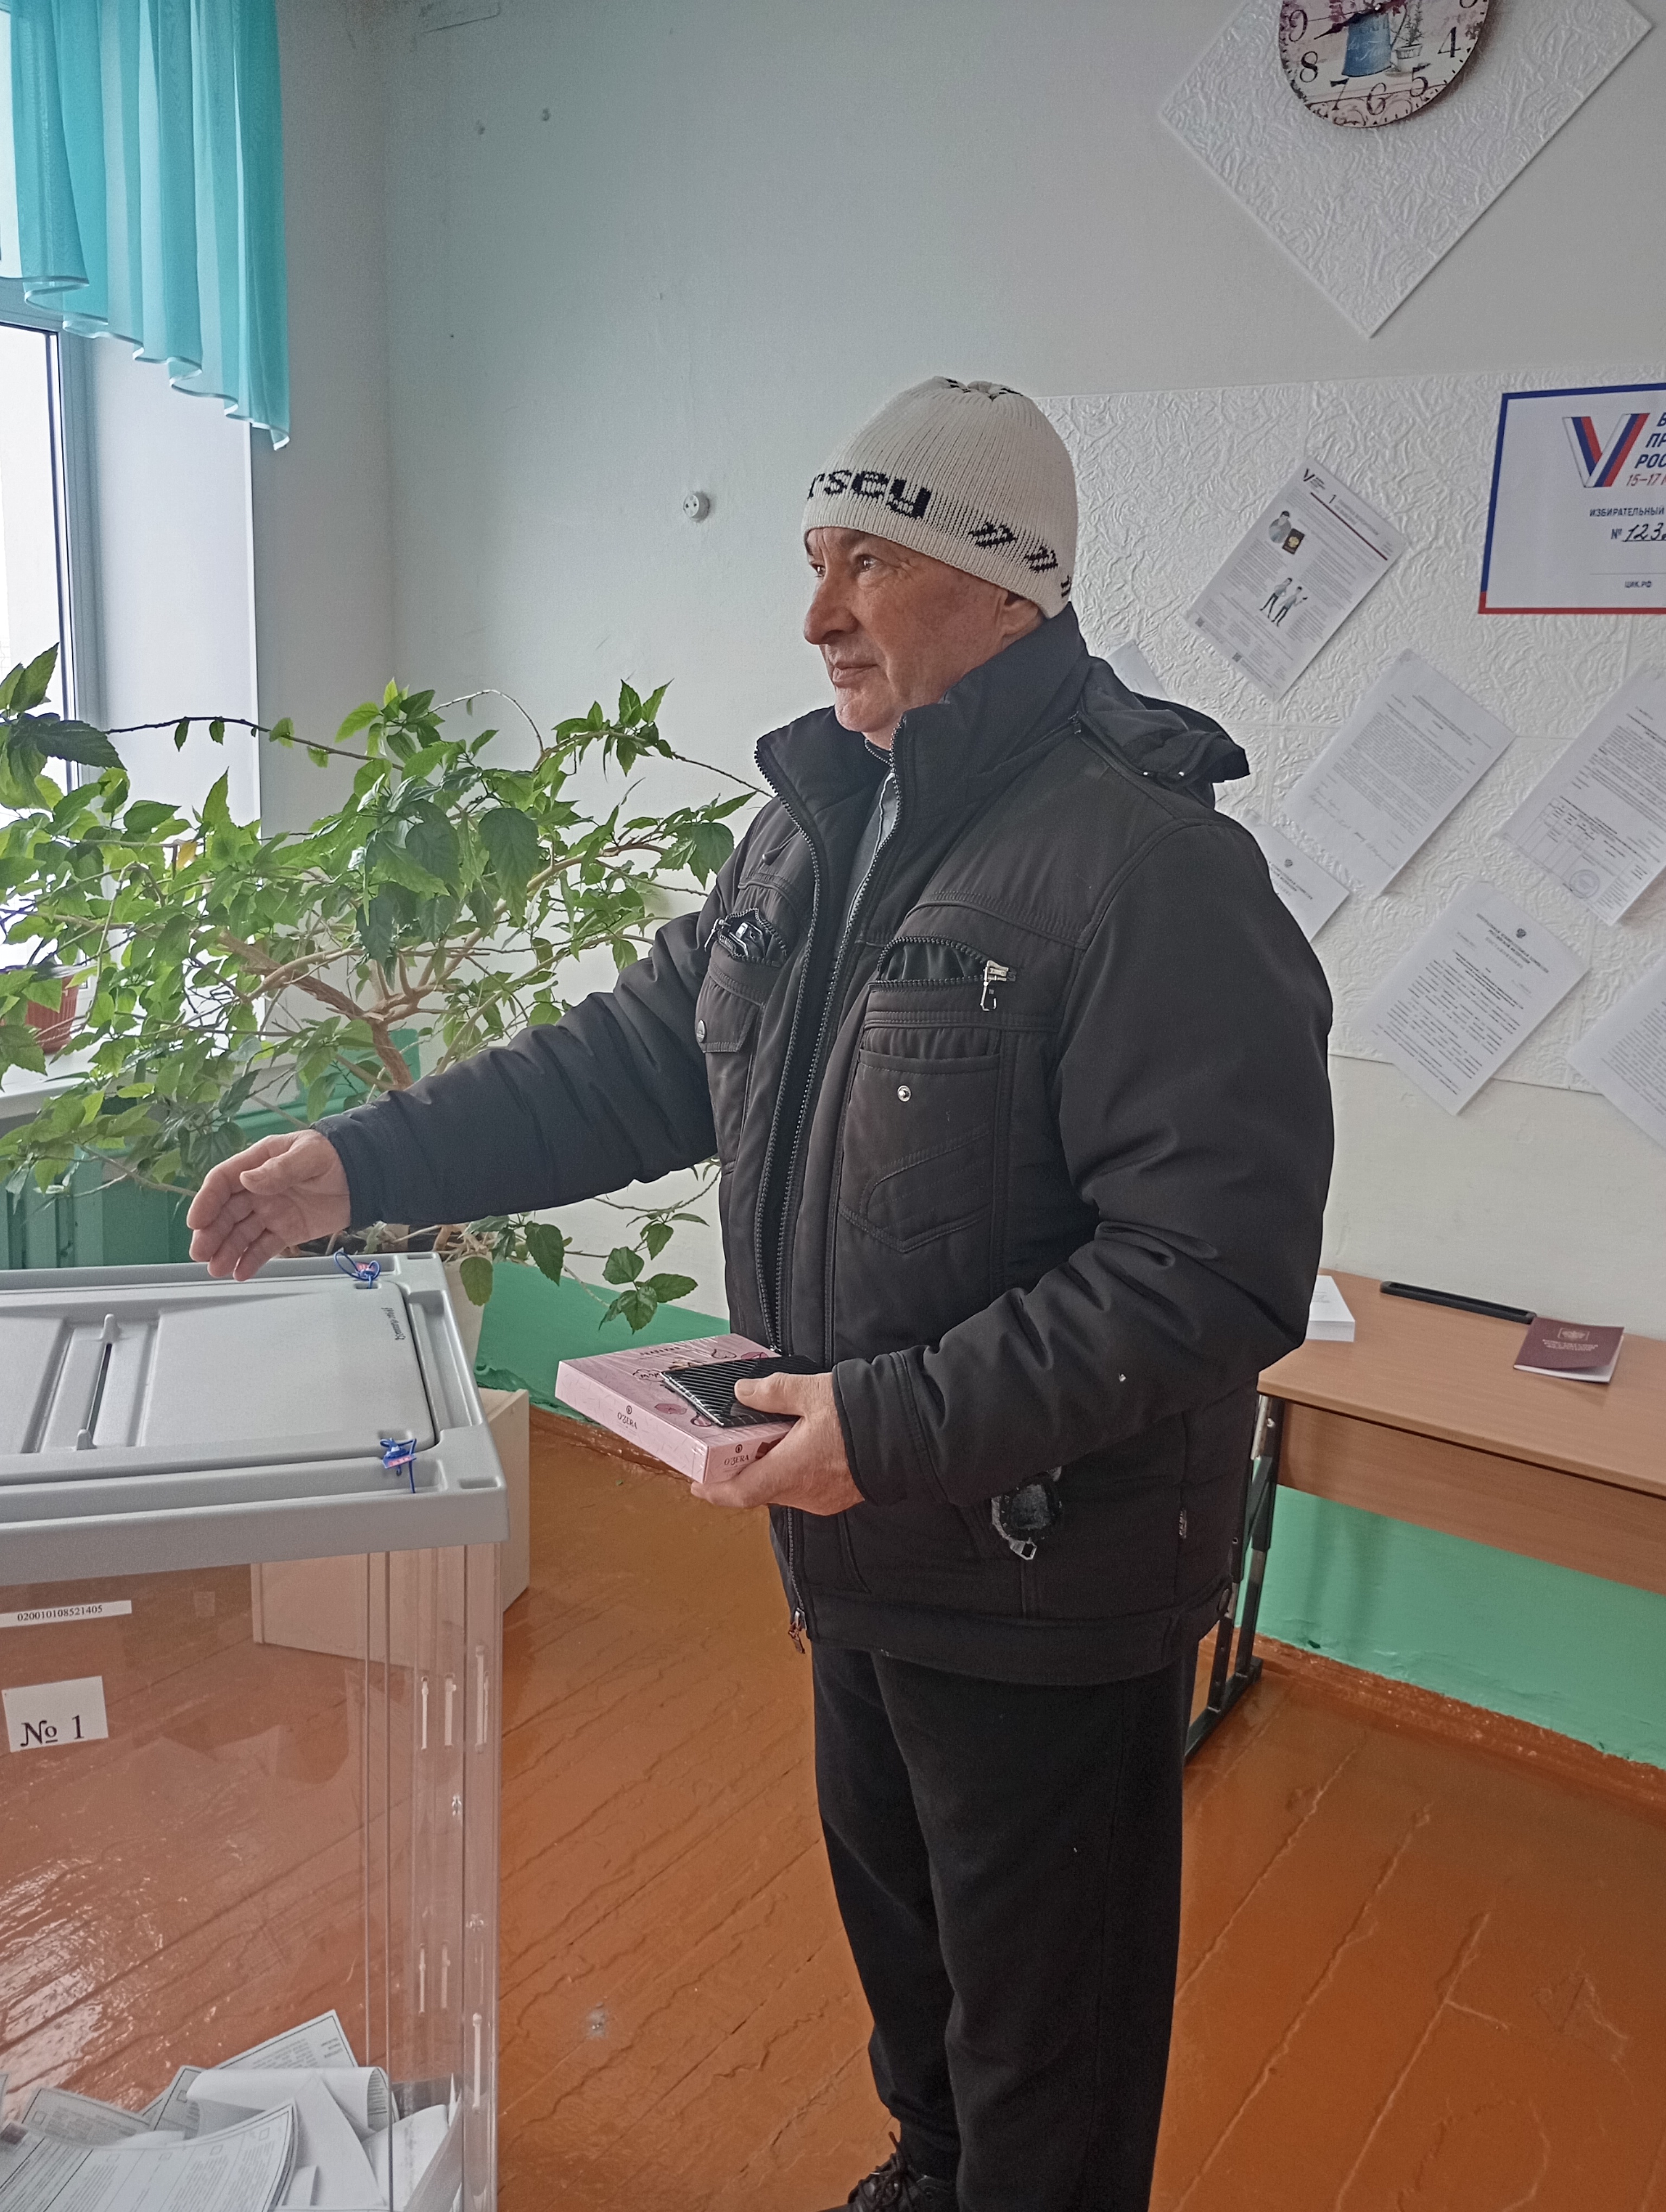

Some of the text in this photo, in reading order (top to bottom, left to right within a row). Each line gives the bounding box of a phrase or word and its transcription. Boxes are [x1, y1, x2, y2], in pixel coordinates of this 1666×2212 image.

[1289, 9, 1308, 42] 9
[1438, 27, 1461, 57] 4
[1300, 51, 1318, 82] 8
[1410, 62, 1431, 97] 5
[1330, 78, 1349, 110] 7
[1367, 82, 1387, 115] 6
[1590, 505, 1665, 517] ИЗБИРАТЕЛЬНЫЙ
[17, 1604, 103, 1622] 020010108521405
[20, 1714, 85, 1747] № 1
